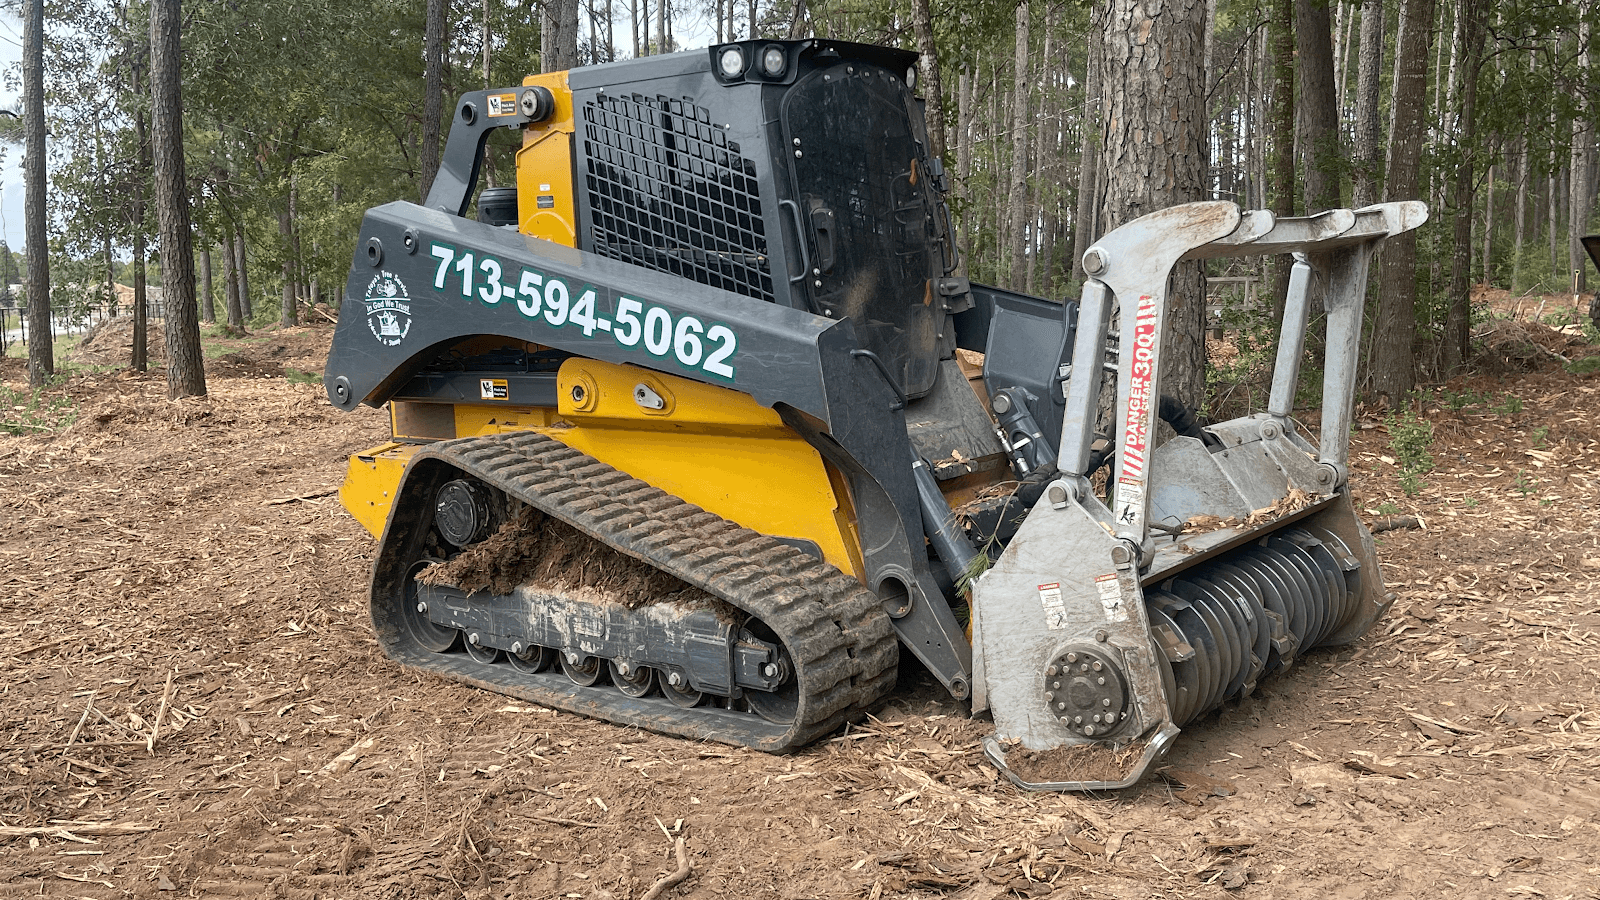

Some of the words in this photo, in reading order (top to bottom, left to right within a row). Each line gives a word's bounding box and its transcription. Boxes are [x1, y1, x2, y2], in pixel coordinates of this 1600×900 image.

[366, 304, 373, 313] In
[372, 301, 385, 310] God
[385, 300, 395, 308] We
[395, 301, 410, 314] Trust
[381, 270, 393, 278] Tree
[394, 274, 409, 298] Service
[431, 245, 737, 379] 713-594-5062
[1126, 376, 1143, 446] DANGER
